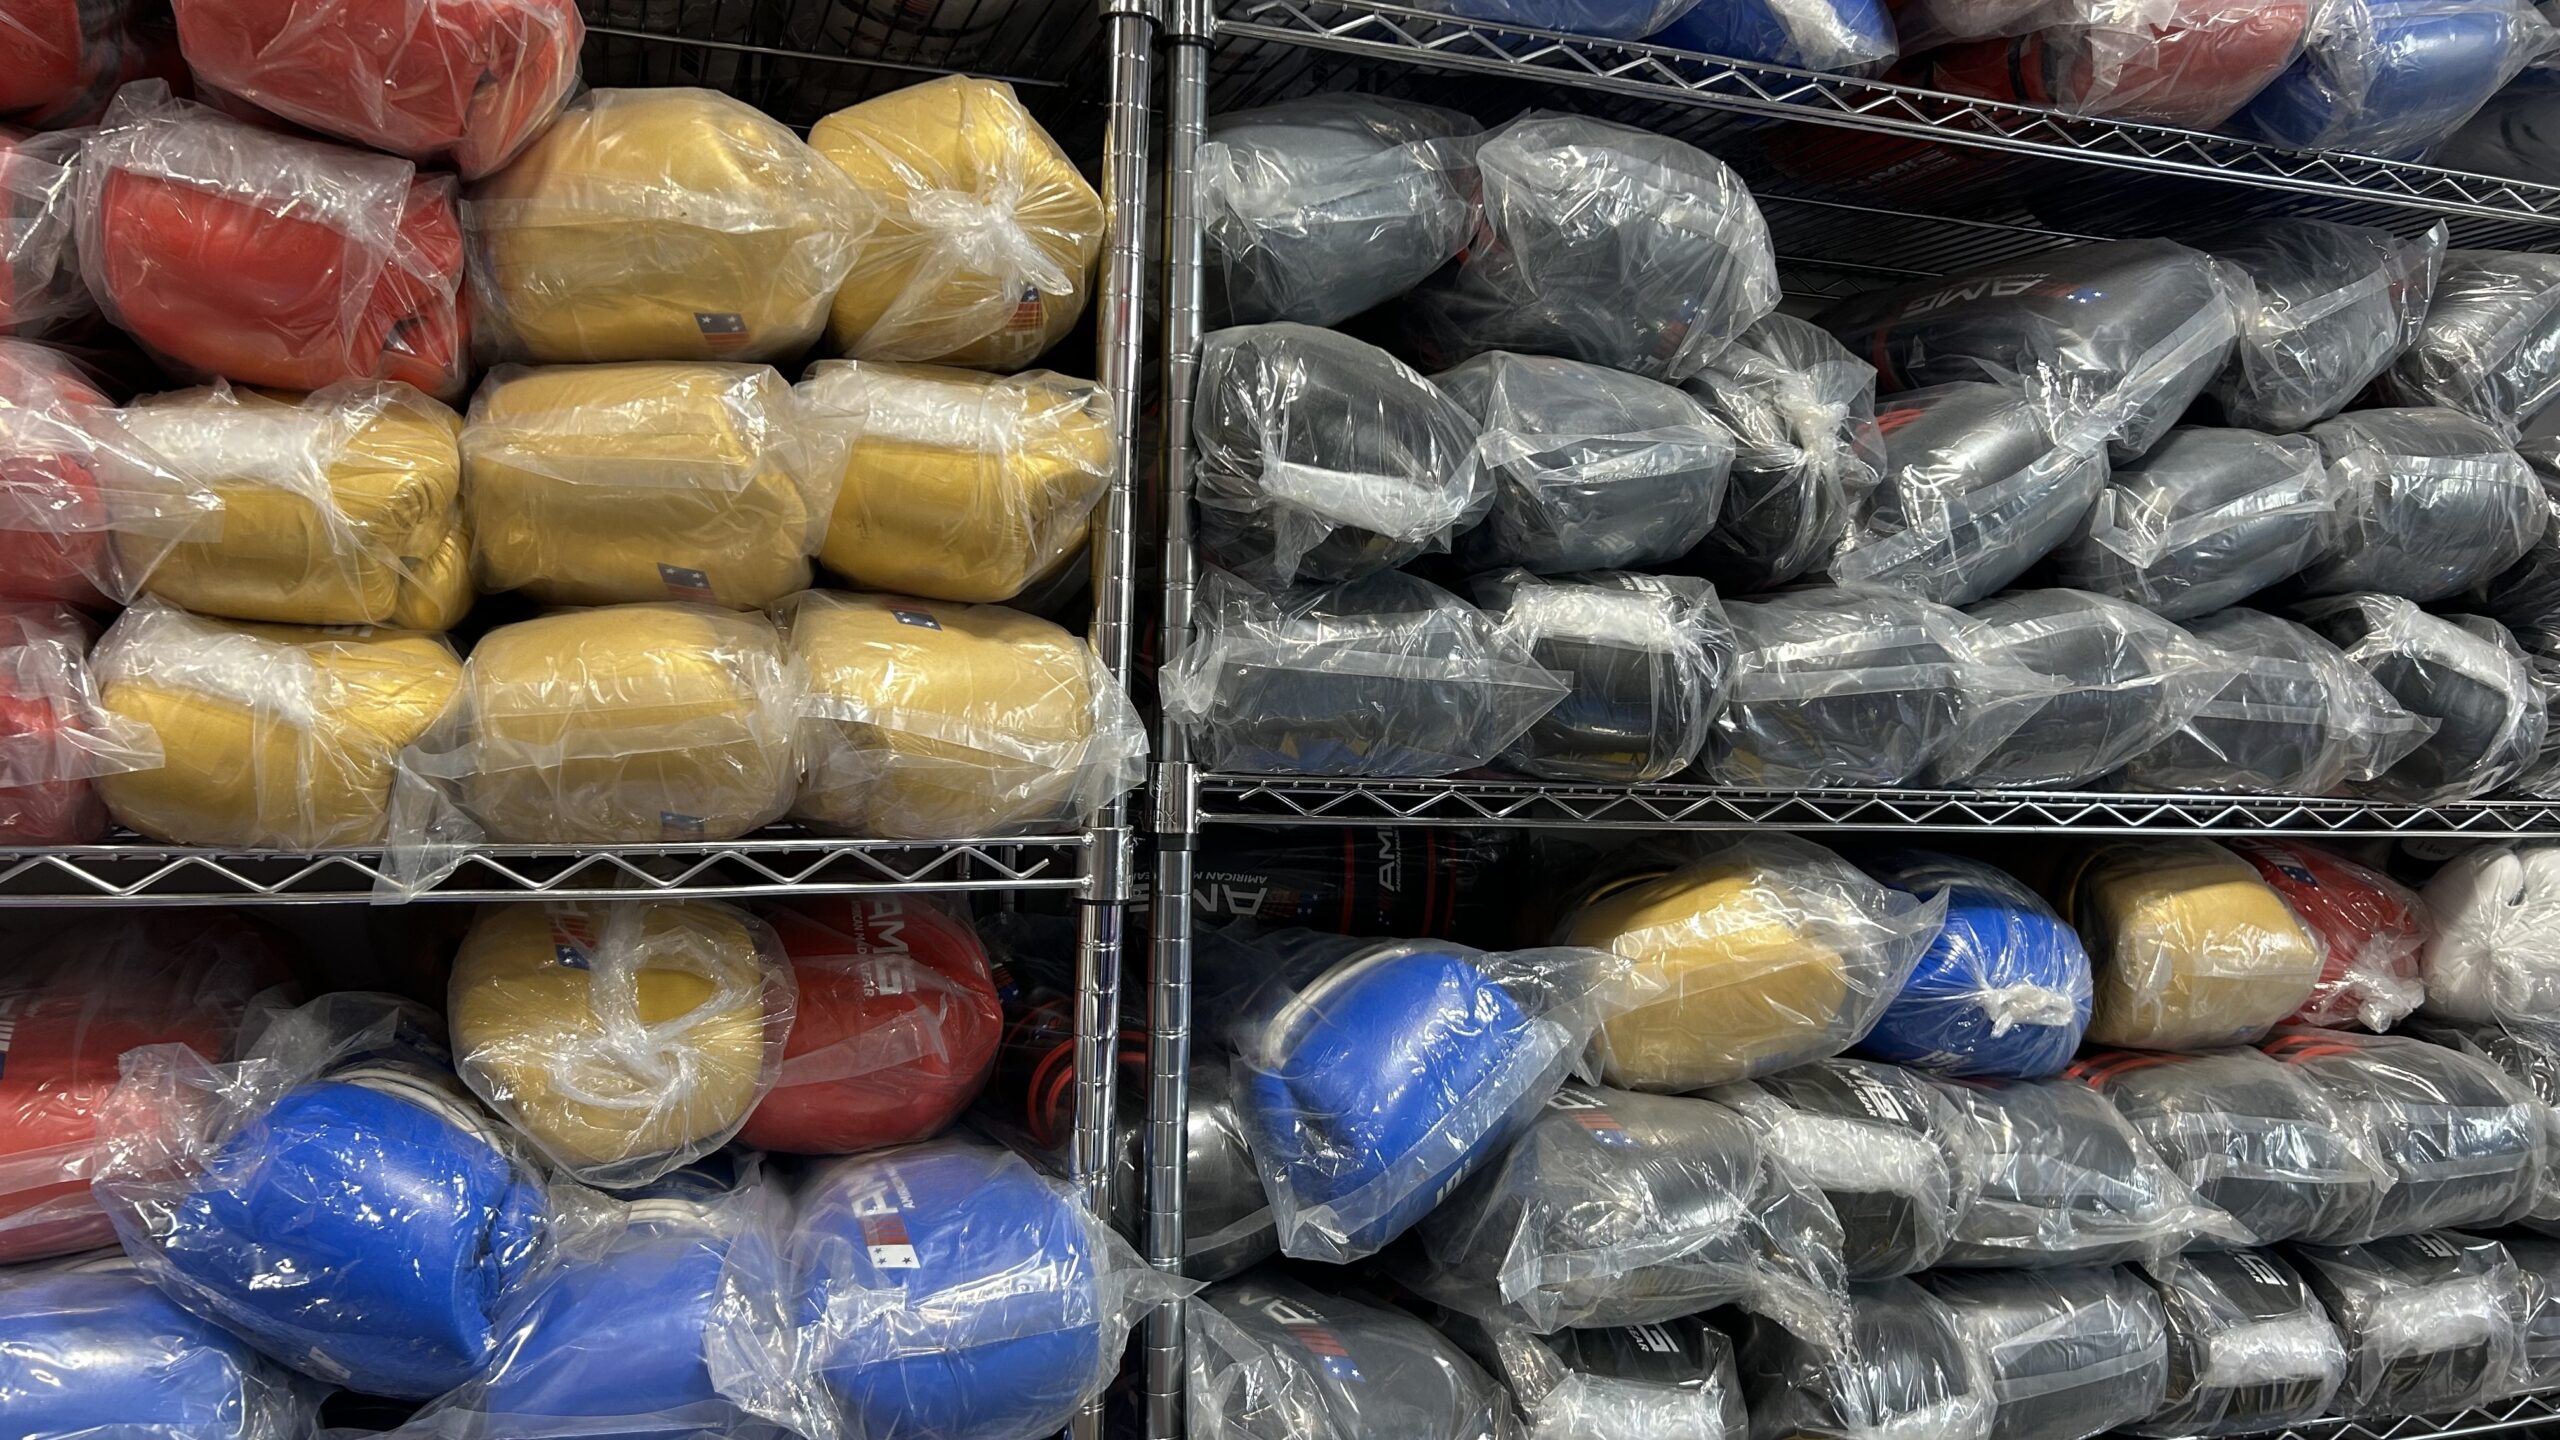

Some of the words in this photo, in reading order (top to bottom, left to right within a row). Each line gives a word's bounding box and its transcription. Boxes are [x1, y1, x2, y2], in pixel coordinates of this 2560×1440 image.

[1205, 872, 1267, 884] AMIRICAN
[854, 932, 868, 955] MAD
[1854, 1088, 1878, 1118] GEAR
